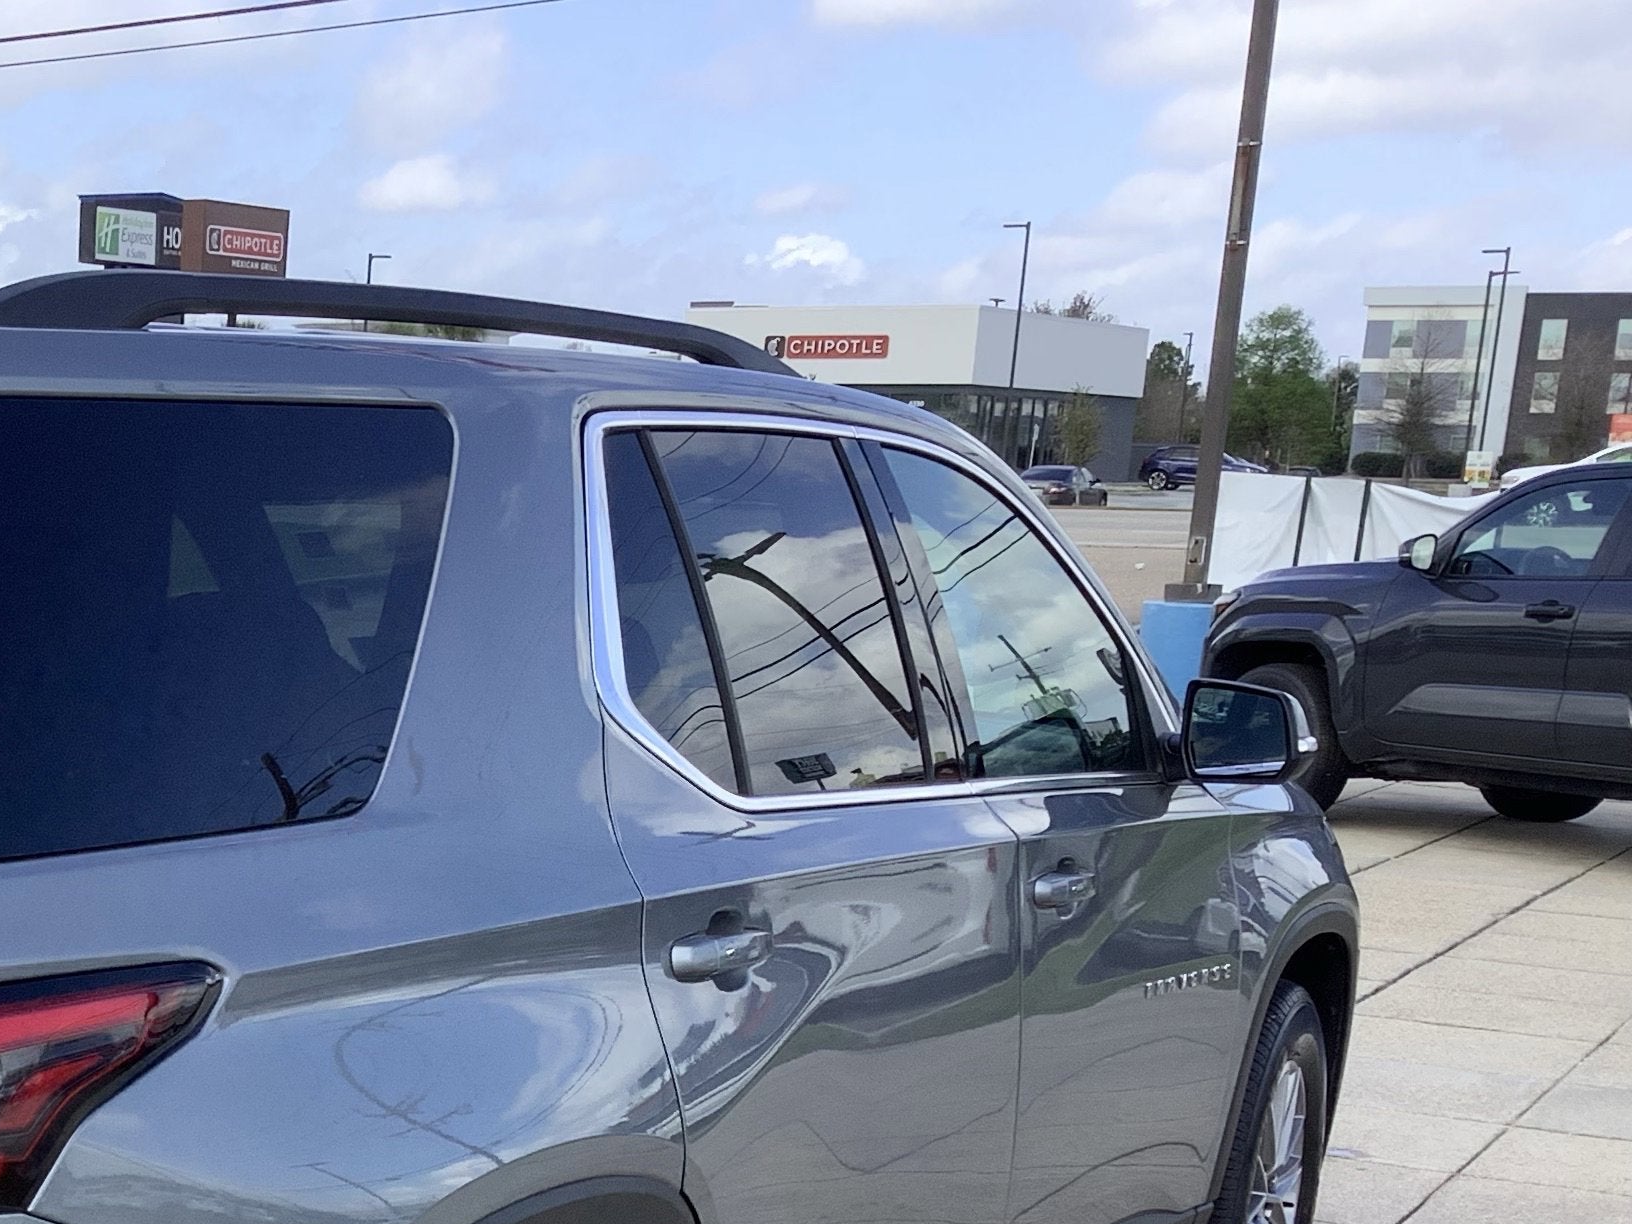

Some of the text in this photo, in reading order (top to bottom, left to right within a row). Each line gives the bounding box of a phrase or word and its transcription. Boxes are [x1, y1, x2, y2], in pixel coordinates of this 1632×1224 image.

[163, 226, 182, 249] HO
[224, 234, 280, 254] CHIPOTLE
[231, 259, 279, 272] MEXICAN GRILL
[789, 339, 884, 354] CHIPOTLE
[1144, 963, 1231, 999] TRAVERSE
